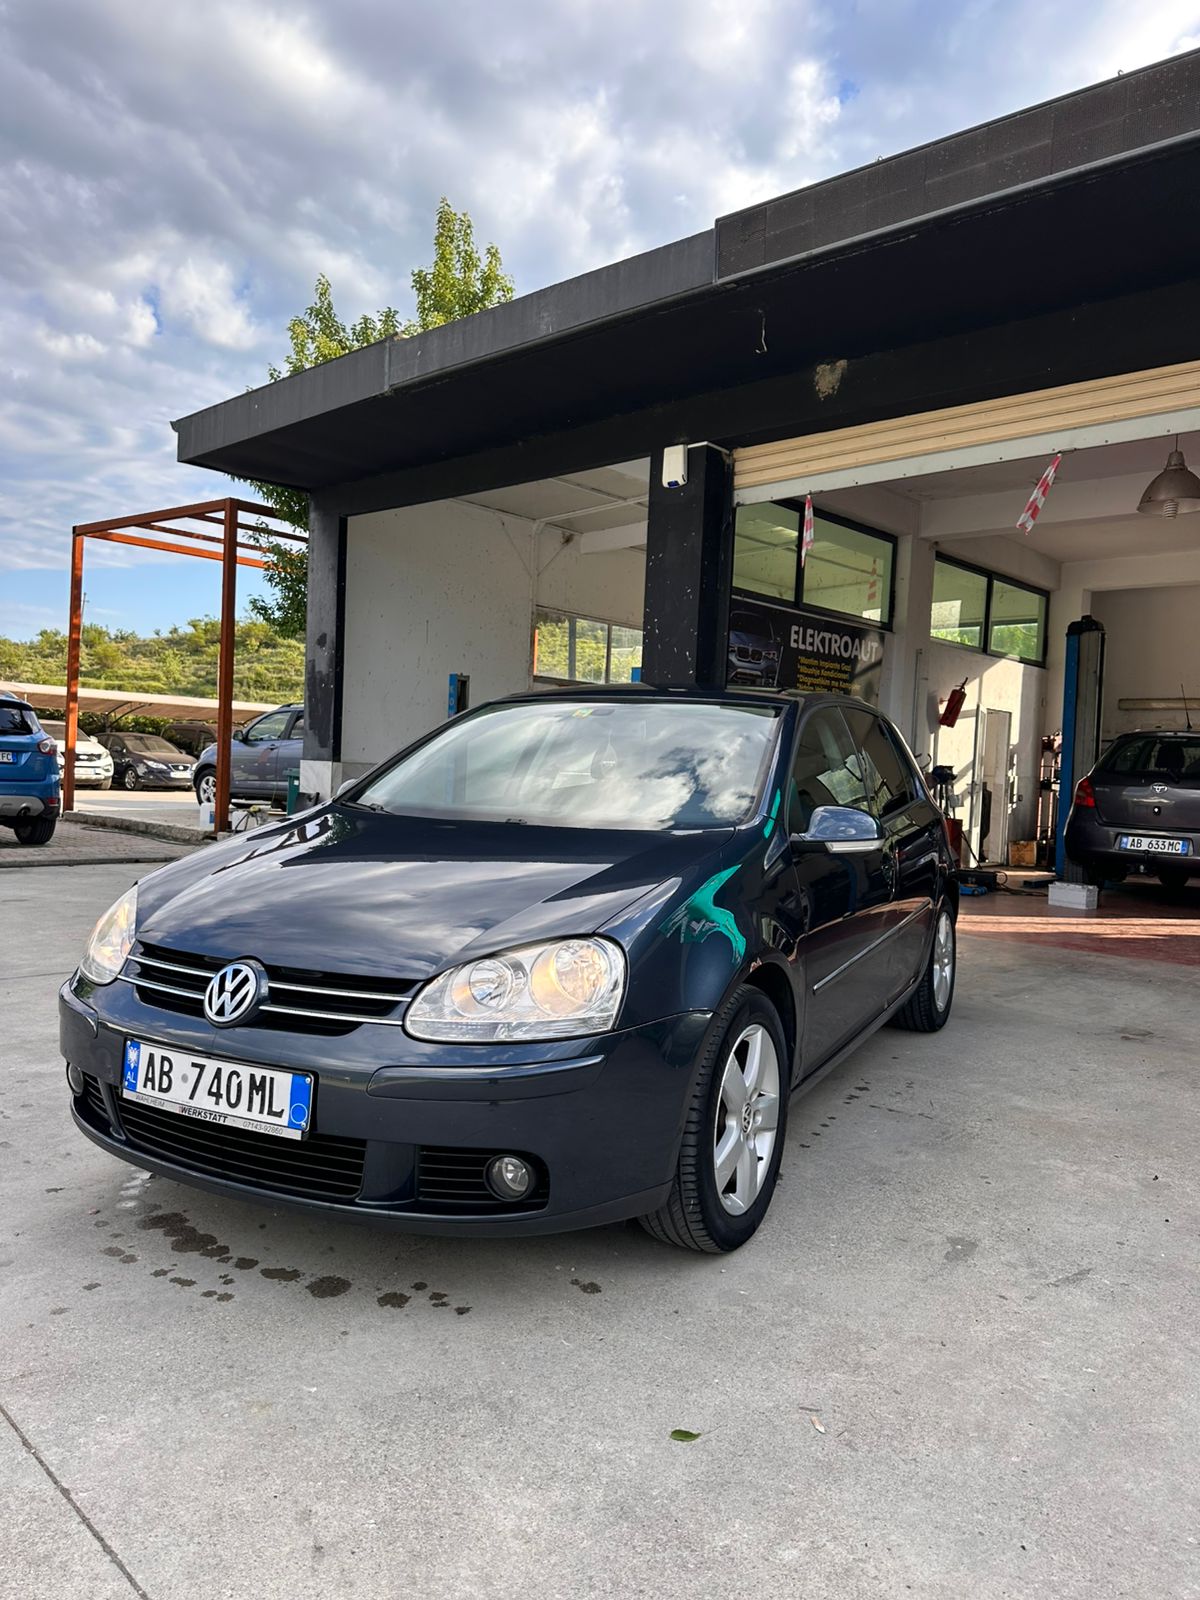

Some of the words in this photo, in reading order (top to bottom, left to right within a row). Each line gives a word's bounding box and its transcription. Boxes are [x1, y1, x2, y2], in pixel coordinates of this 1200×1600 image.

[790, 625, 878, 662] ELEKTROAUT
[1129, 838, 1143, 849] AB
[126, 1071, 137, 1084] AL
[143, 1052, 174, 1094] AB
[180, 1106, 229, 1123] WERKSTATT
